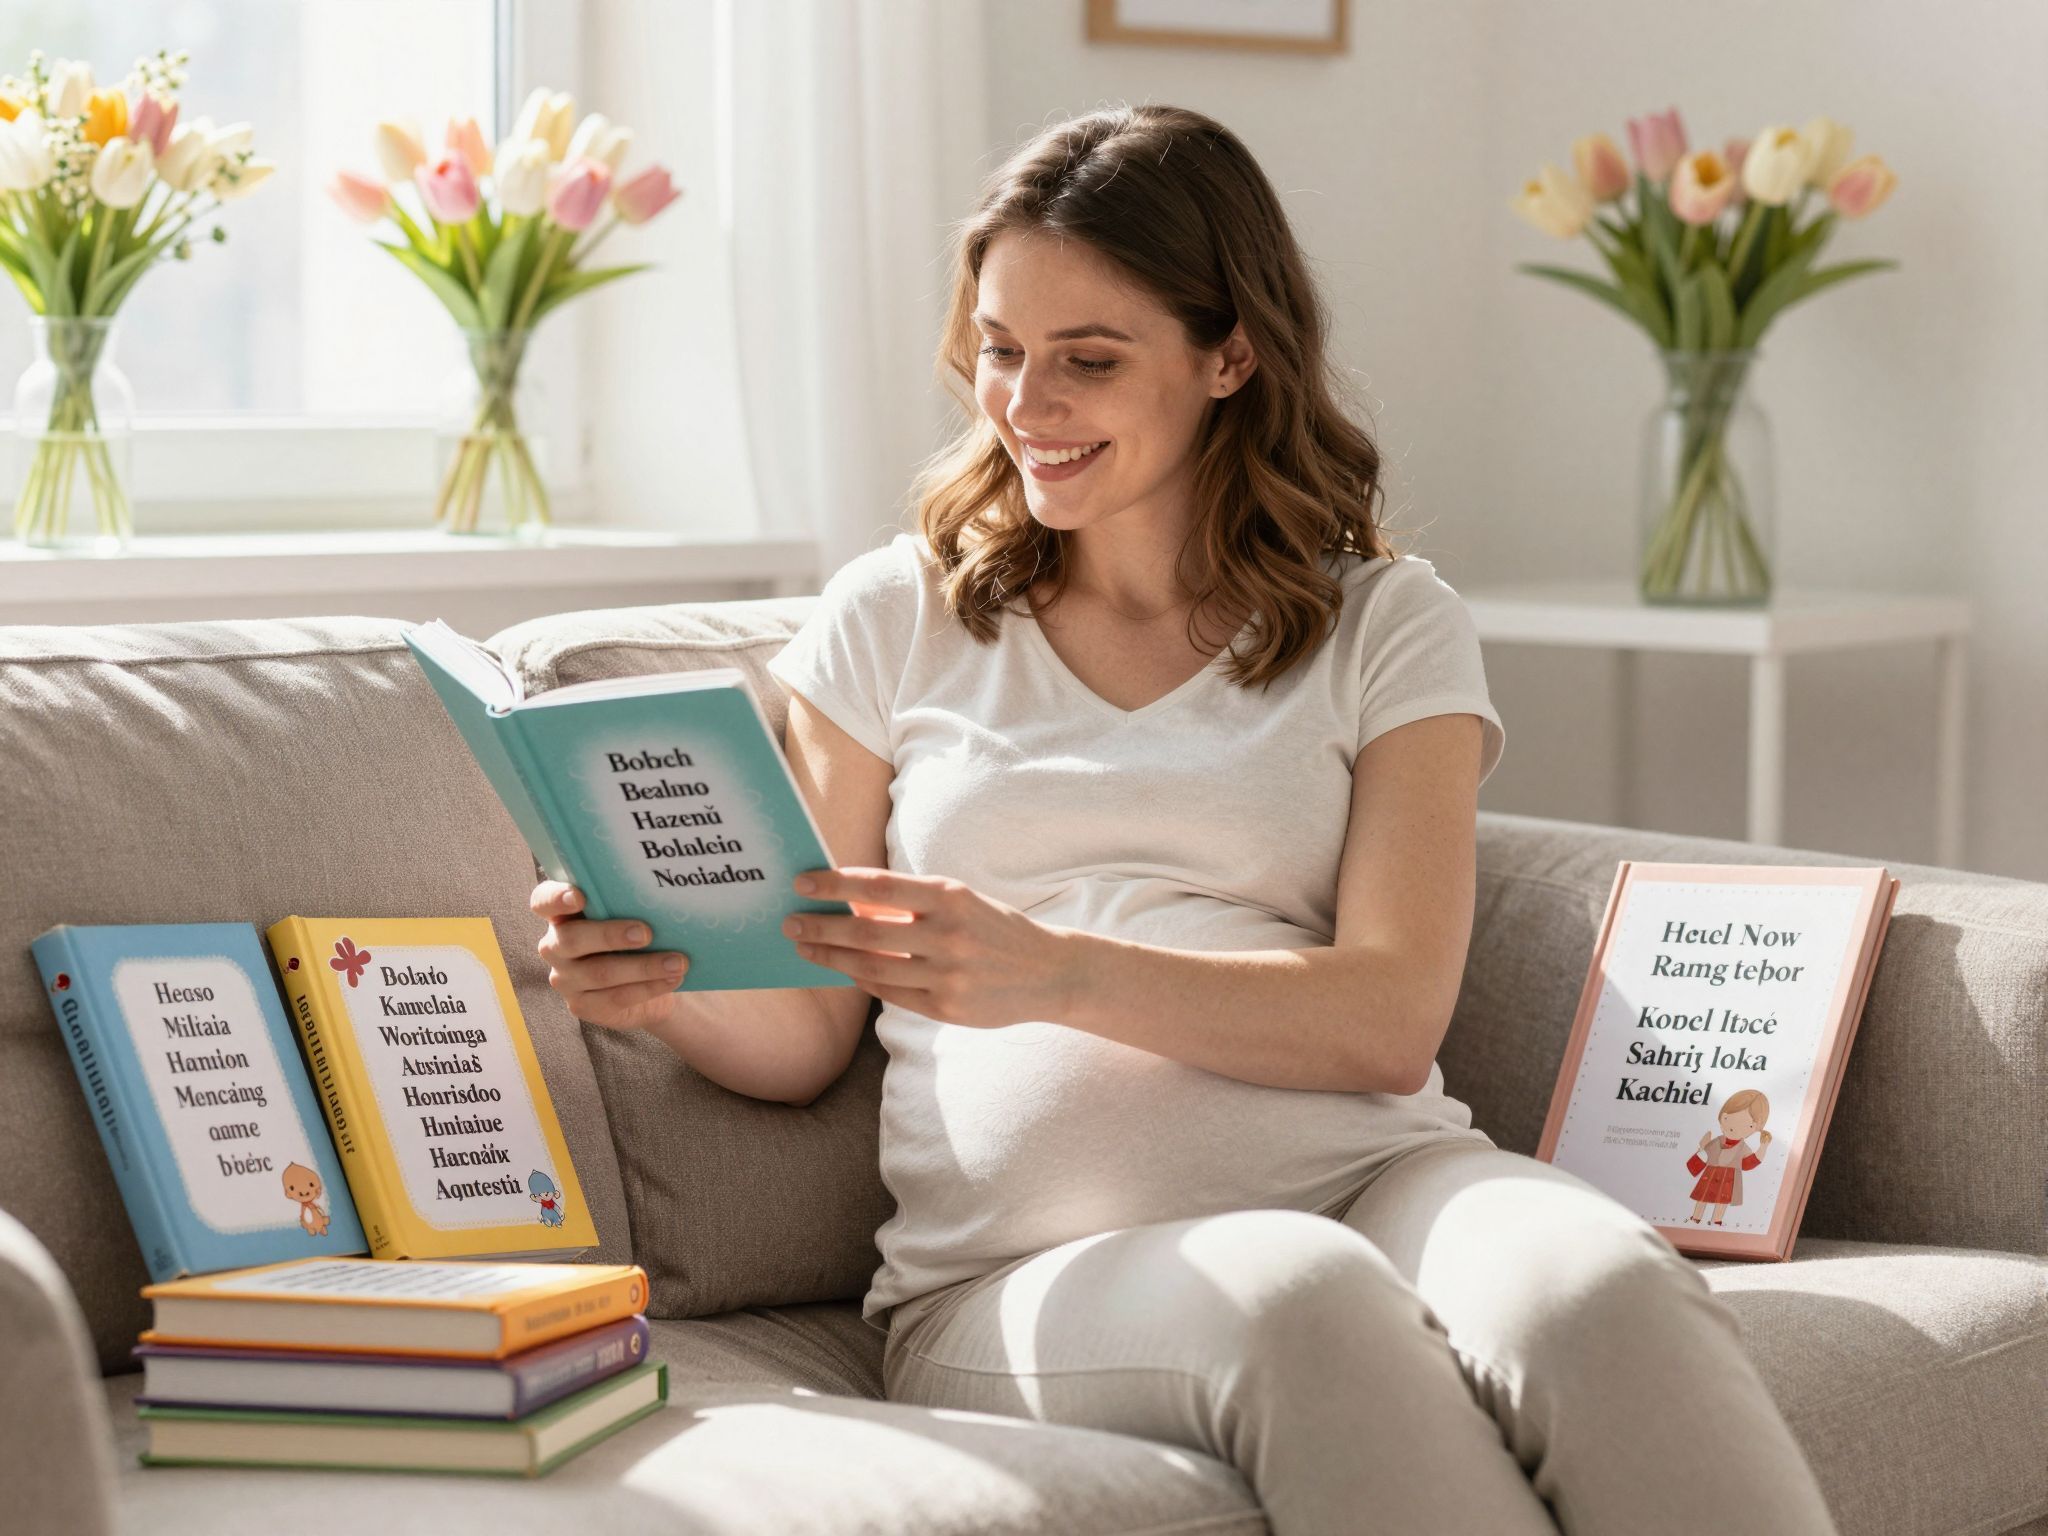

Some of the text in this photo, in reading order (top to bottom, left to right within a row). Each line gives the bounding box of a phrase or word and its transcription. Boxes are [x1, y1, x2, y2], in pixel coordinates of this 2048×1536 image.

[1739, 924, 1802, 947] Now
[1710, 1046, 1767, 1071] loka
[1616, 1077, 1713, 1106] Kachiel
